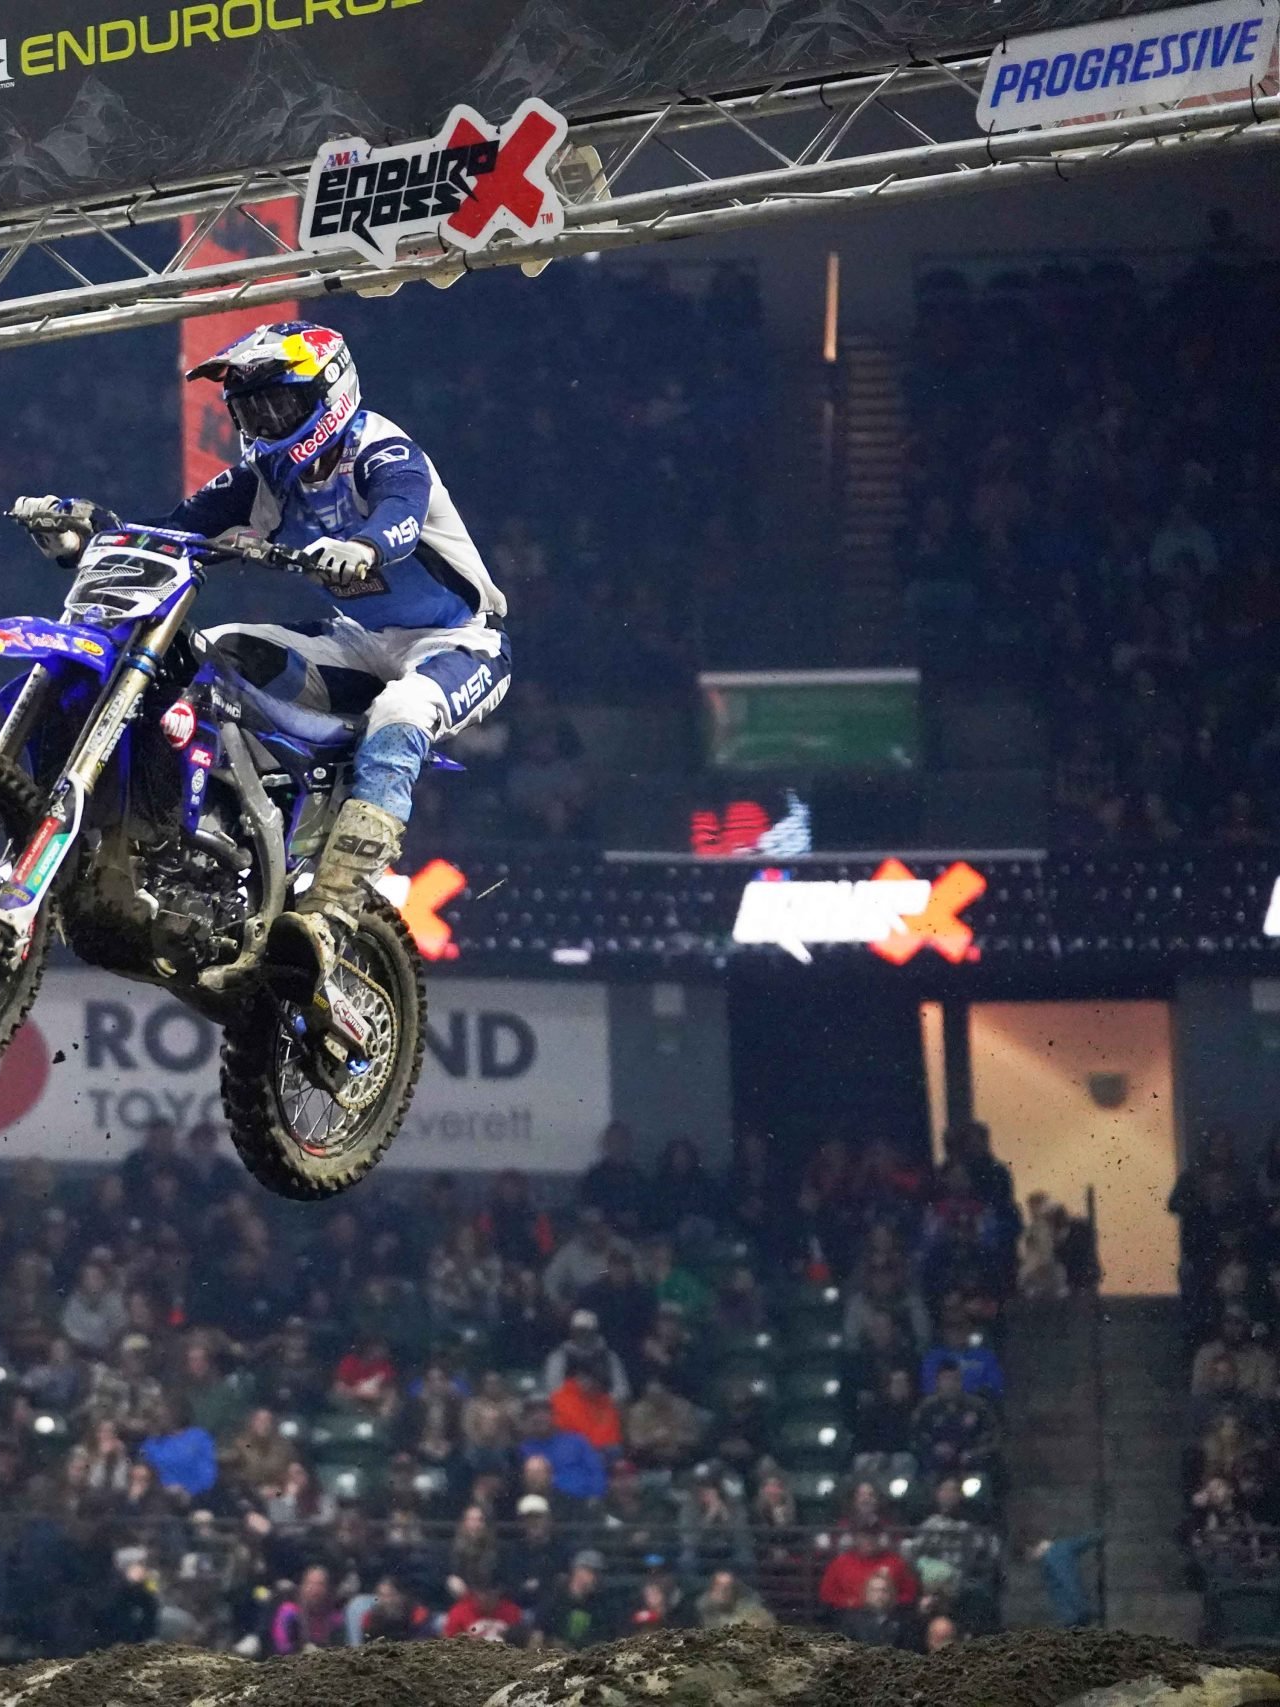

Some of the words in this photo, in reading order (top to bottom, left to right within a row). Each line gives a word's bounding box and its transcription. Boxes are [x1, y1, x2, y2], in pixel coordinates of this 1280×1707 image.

[20, 0, 422, 76] ENDUROCR
[989, 17, 1264, 109] PROGRESSIVE
[322, 149, 361, 171] AMA
[288, 421, 326, 465] Red
[322, 392, 353, 437] Bull
[32, 516, 63, 528] ASV
[382, 515, 420, 548] MSR
[450, 663, 493, 716] MSR
